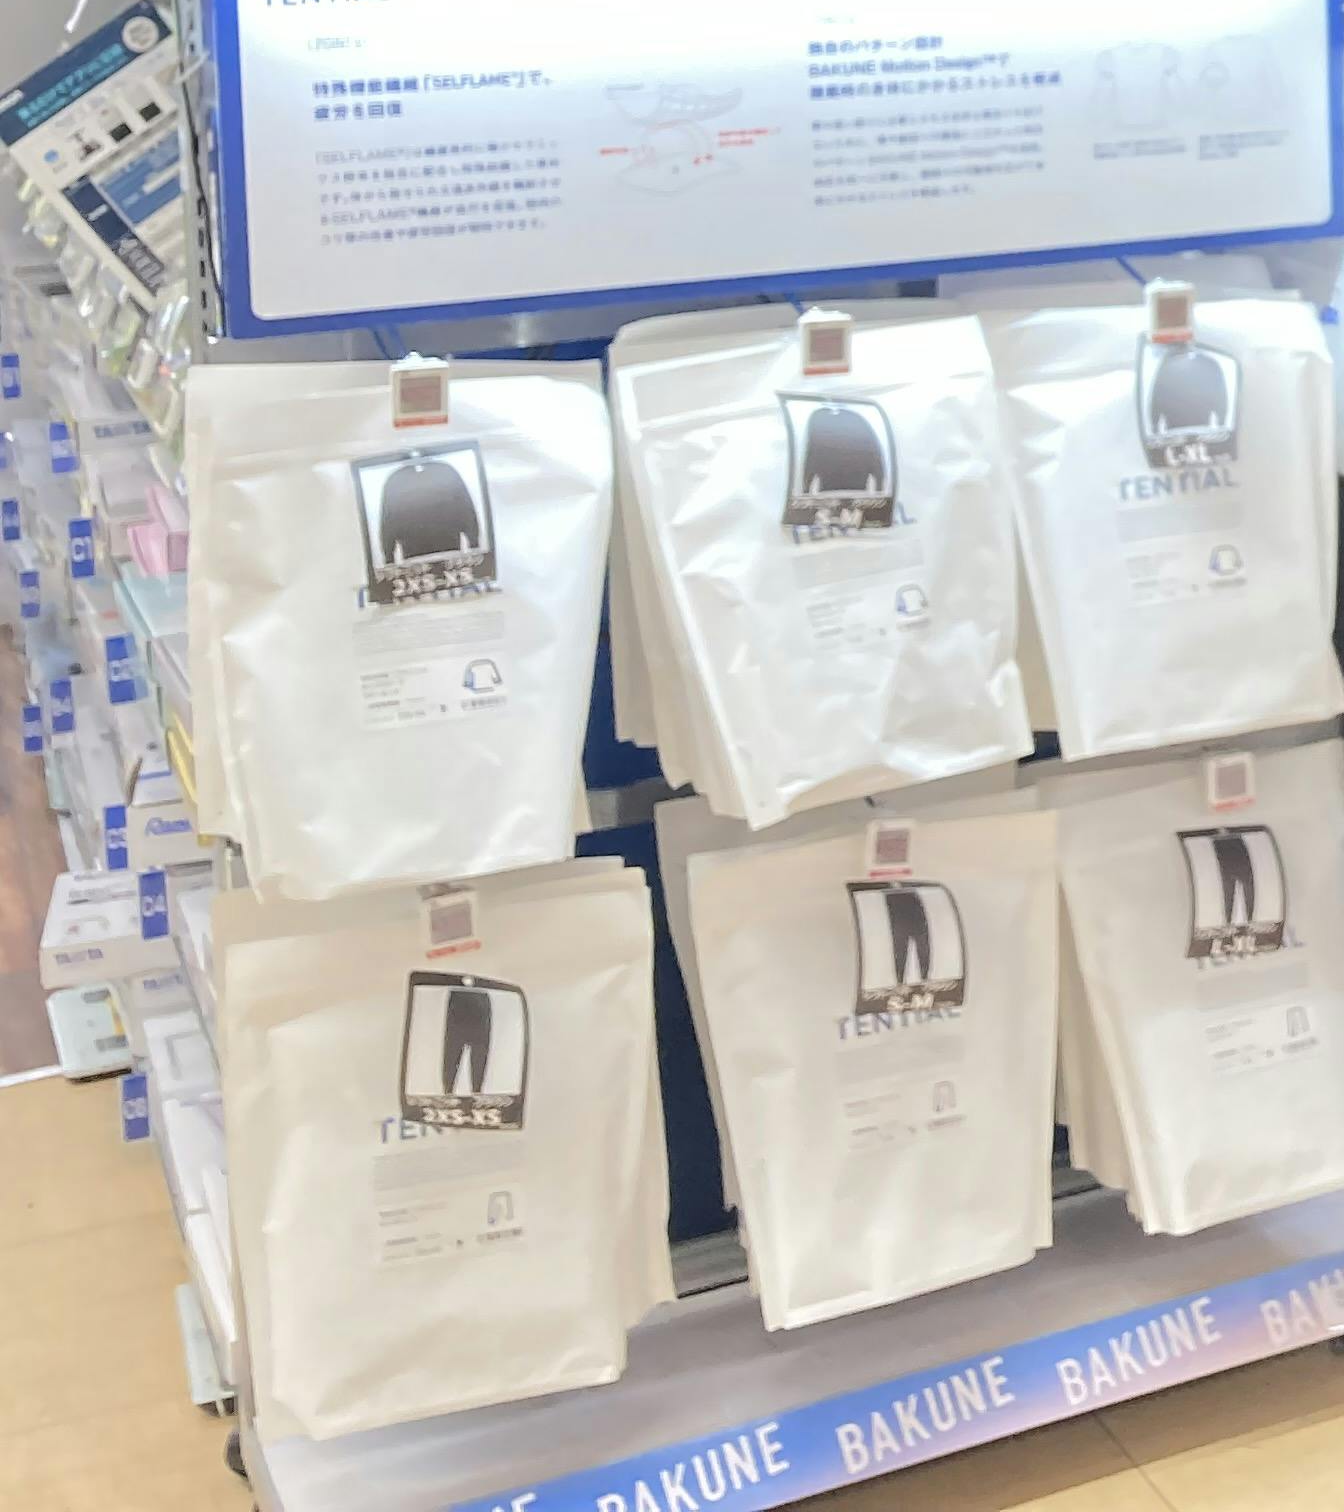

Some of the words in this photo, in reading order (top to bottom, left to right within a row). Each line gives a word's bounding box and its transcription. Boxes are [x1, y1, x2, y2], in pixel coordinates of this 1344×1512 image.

[808, 59, 877, 78] BAKUNE
[1118, 467, 1241, 502] TENTIAL
[834, 1356, 1017, 1477] BAKUNE
[1054, 1296, 1224, 1407] BAKUNE
